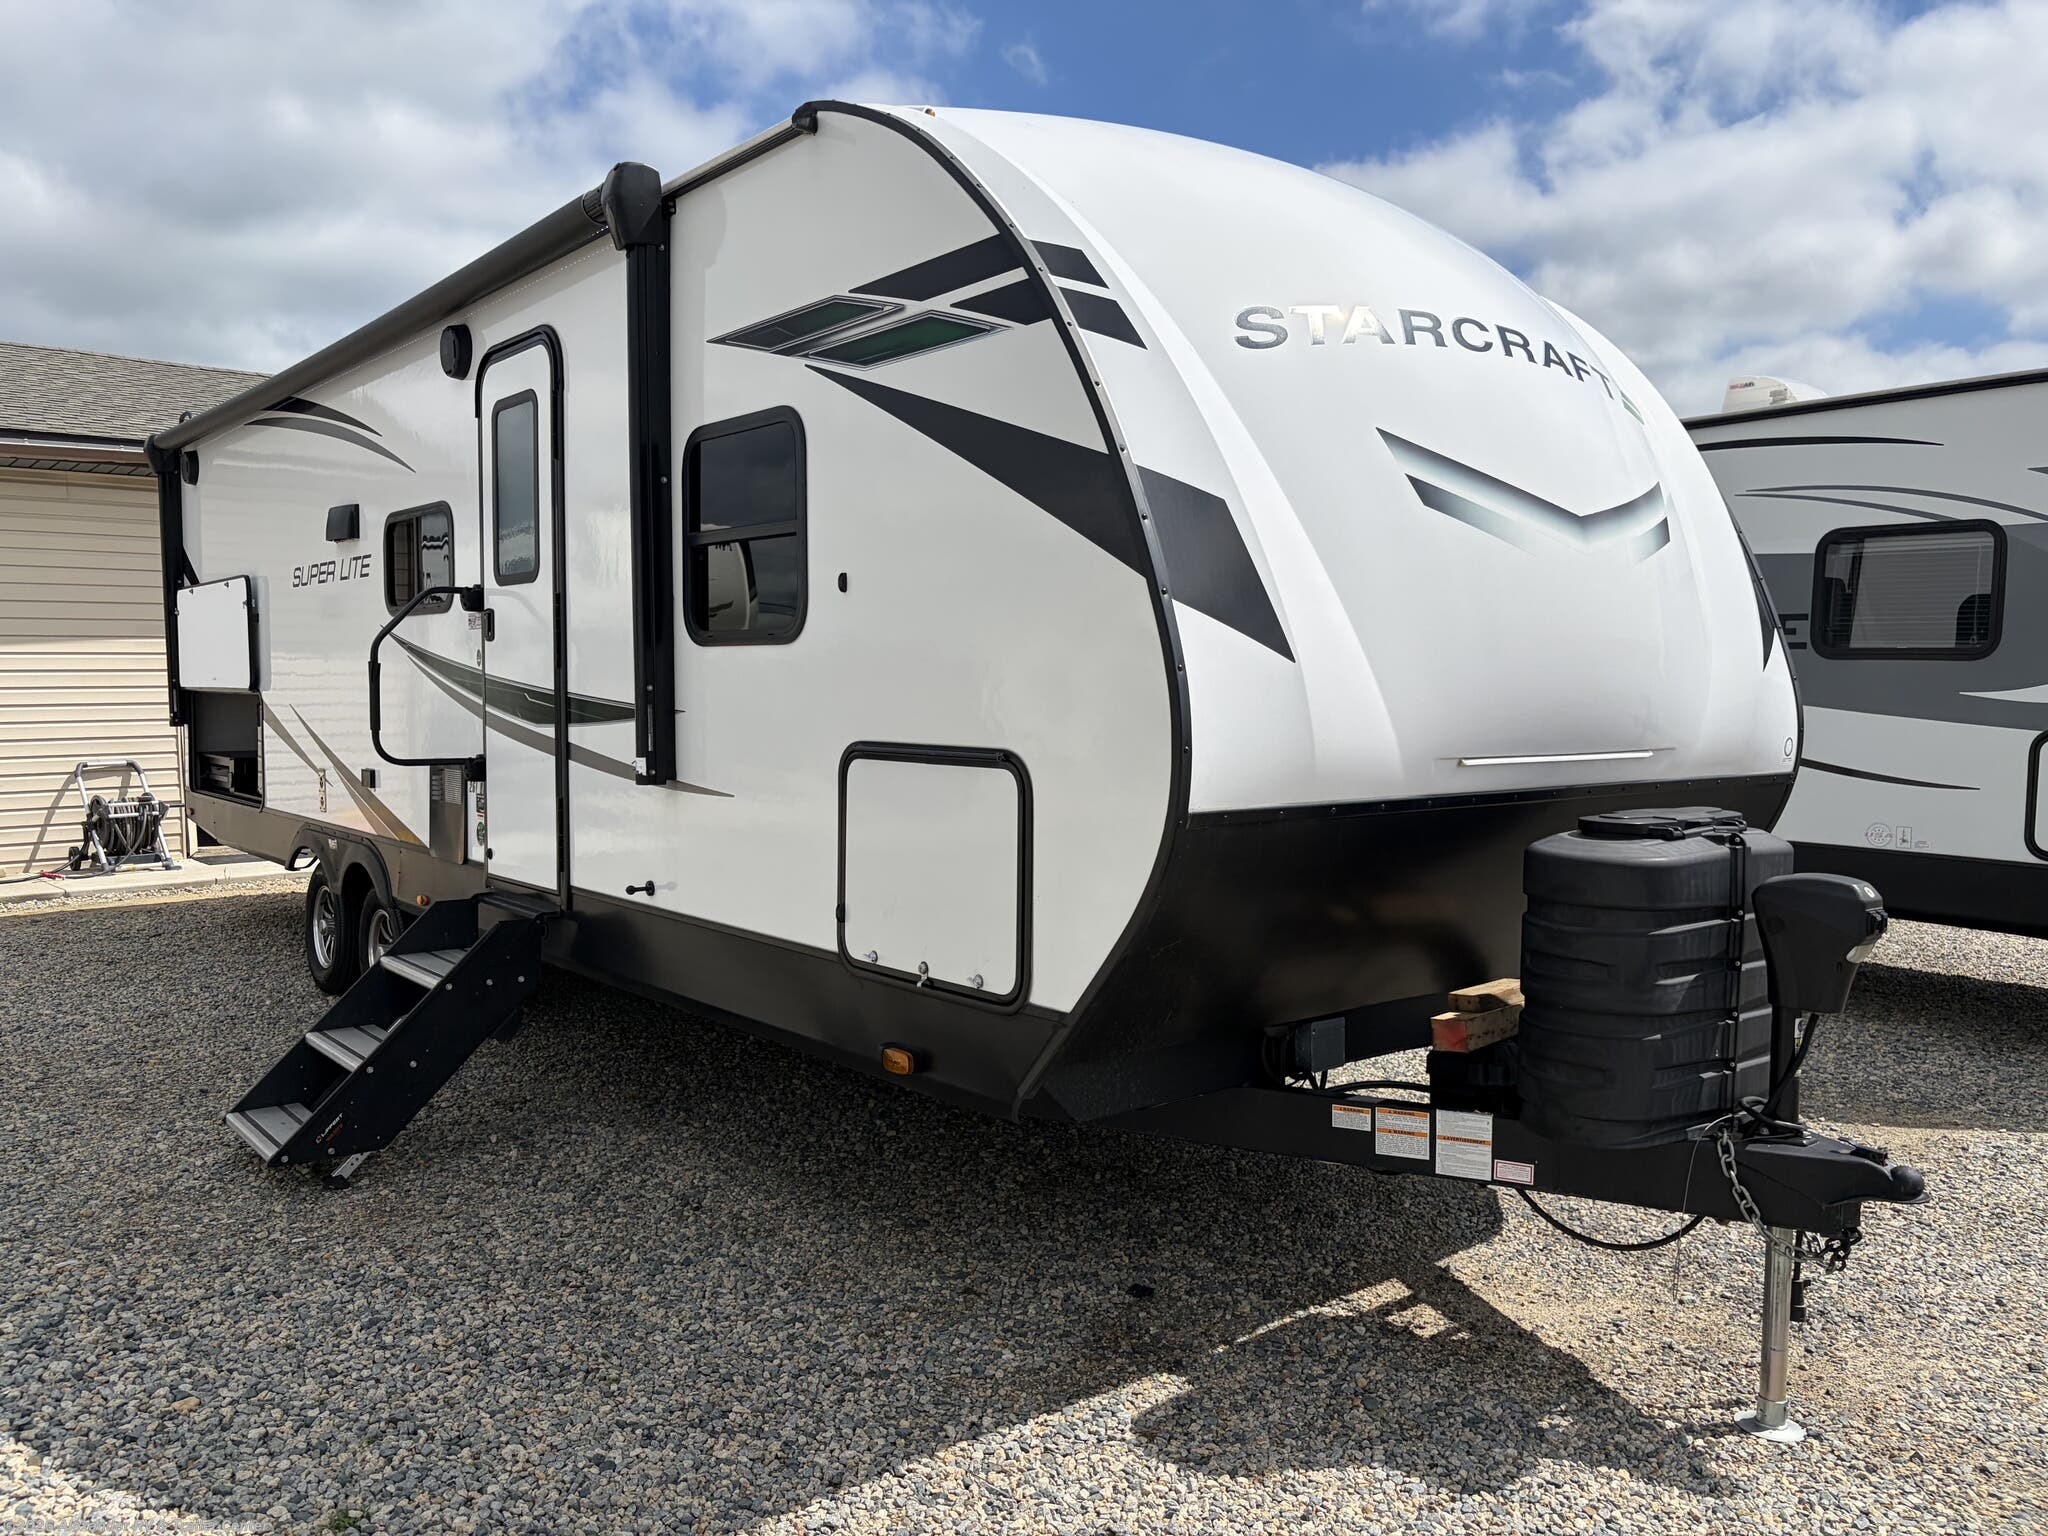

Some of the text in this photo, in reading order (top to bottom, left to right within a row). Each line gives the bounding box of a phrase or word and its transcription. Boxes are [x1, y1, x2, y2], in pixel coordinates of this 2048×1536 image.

[1234, 304, 1615, 400] STARCRAFT
[292, 554, 372, 588] SUPER LITE
[1446, 1135, 1486, 1145] AVERTISSEMENT
